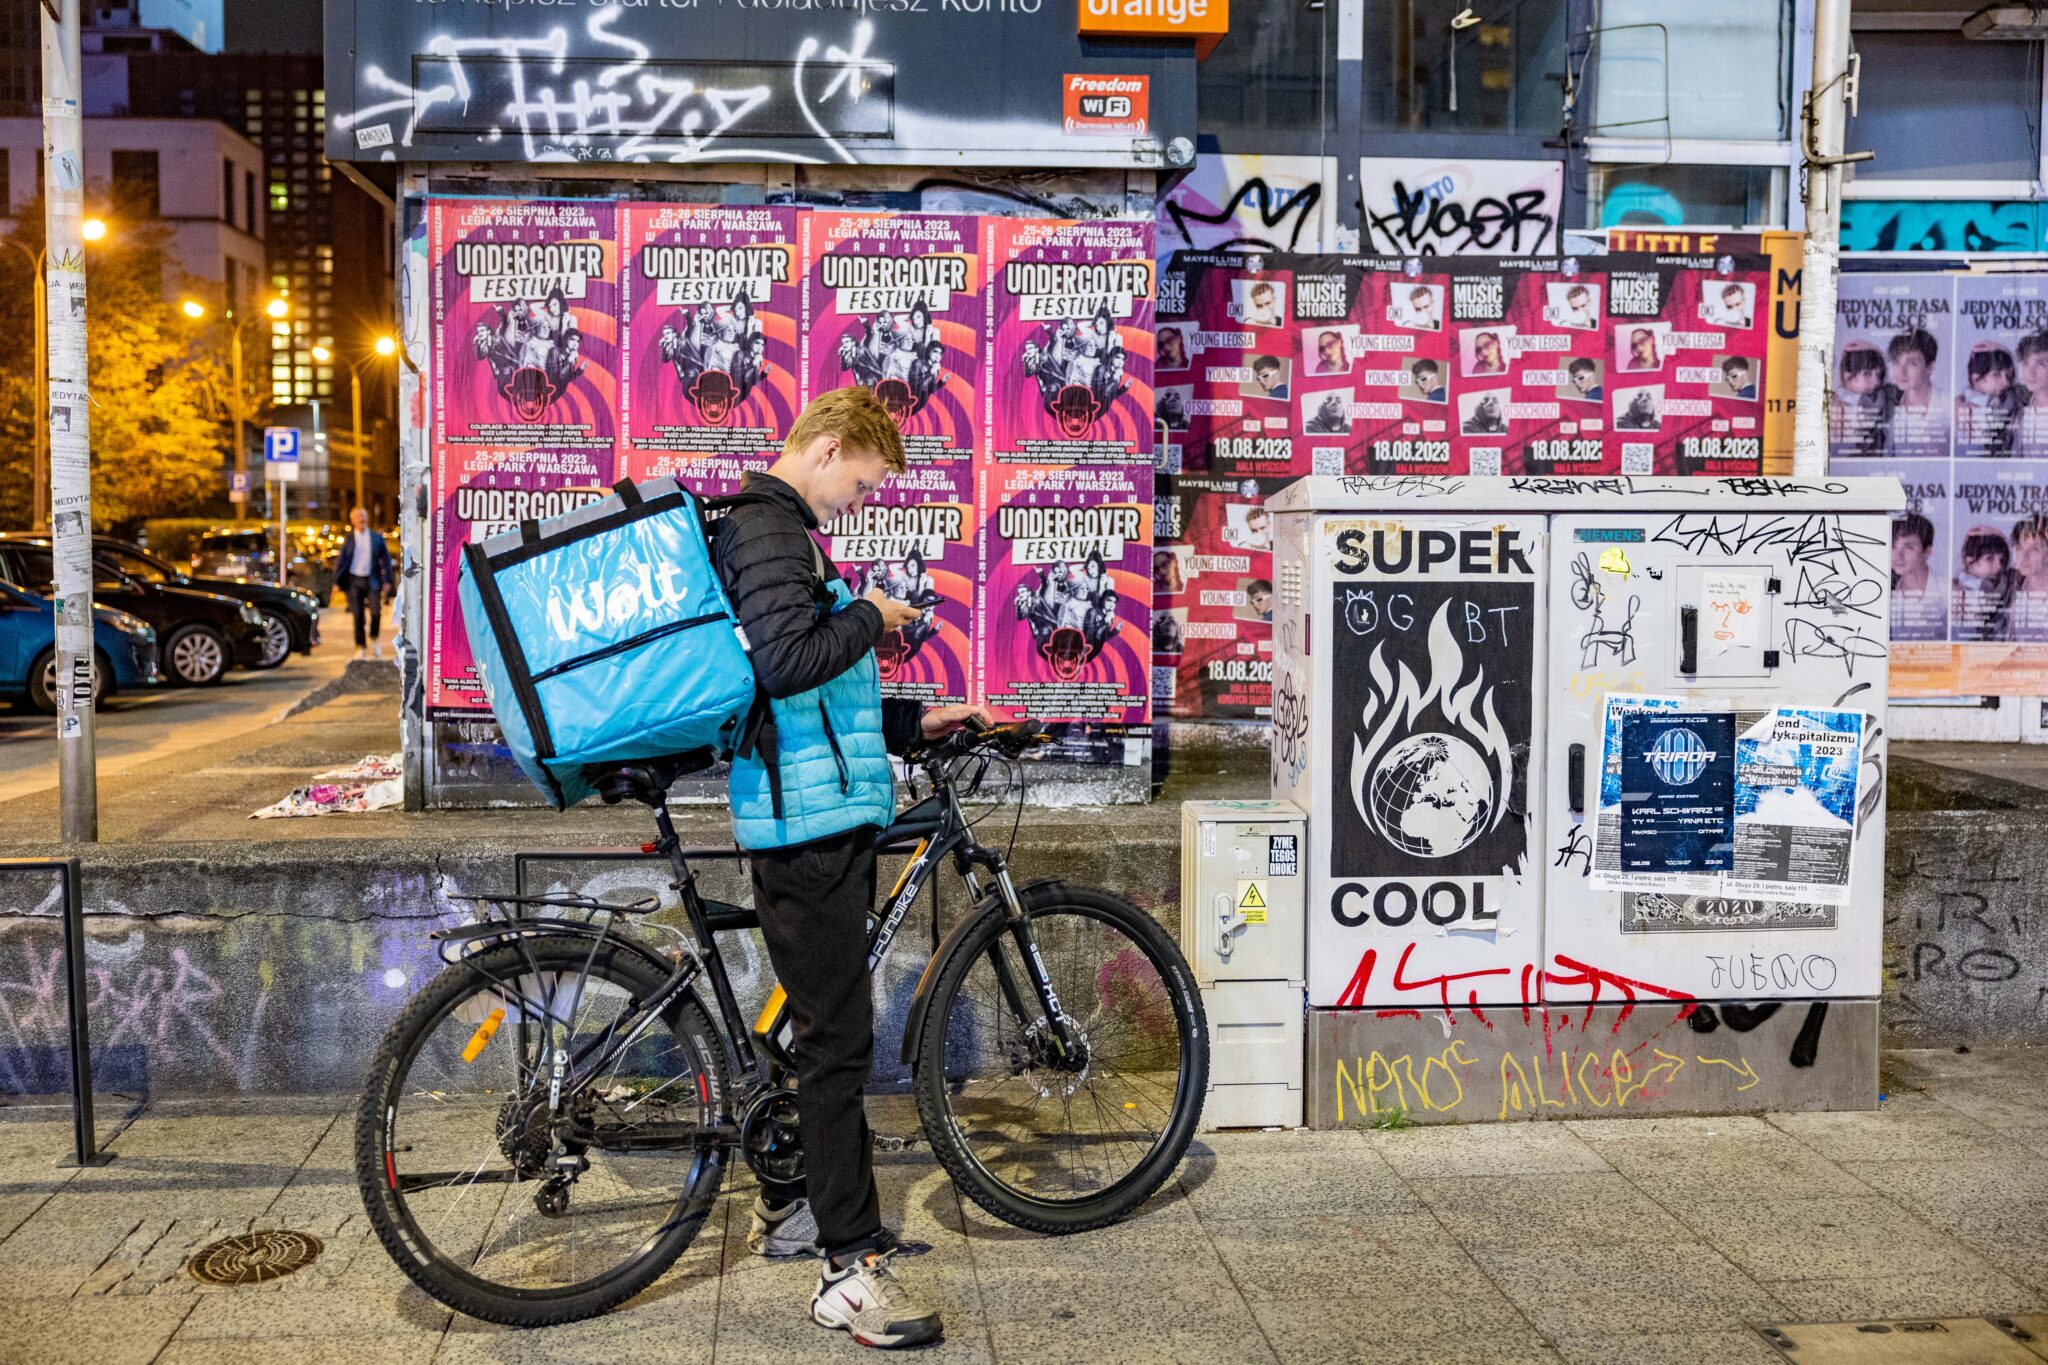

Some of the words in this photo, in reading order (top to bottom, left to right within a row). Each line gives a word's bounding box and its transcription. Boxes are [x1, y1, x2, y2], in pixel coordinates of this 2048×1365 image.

[1088, 0, 1207, 23] orange
[1070, 78, 1142, 92] Freedom
[472, 205, 502, 215] 25-26
[506, 206, 556, 216] SIERPNIA
[559, 207, 585, 217] 2023
[660, 209, 690, 218] 25-26
[694, 209, 743, 220] SIERPNIA
[746, 210, 771, 221] 2023
[461, 215, 492, 226] LEGIA
[495, 216, 524, 226] PARK
[534, 216, 596, 227] WARSZAWA
[649, 218, 680, 229] LEGIA
[683, 219, 710, 230] PARK
[722, 220, 782, 231] WARSZAWA
[840, 218, 870, 228] 25-26
[873, 219, 922, 230] SIERPNIA
[925, 220, 950, 230] 2023
[829, 228, 859, 238] LEGIA
[862, 228, 890, 240] PARK
[900, 230, 960, 241] WARSZAWA
[1024, 226, 1053, 236] 25-26
[1056, 227, 1105, 237] SIERPNIA
[1107, 228, 1132, 237] 2023
[1013, 236, 1042, 246] LEGIA
[1046, 236, 1073, 246] PARK
[1084, 237, 1143, 247] WARSZAWA
[456, 243, 601, 276] UNDERCOVER
[643, 247, 788, 281] UNDERCOVER
[1183, 255, 1242, 264] MAYBELLINE
[1344, 259, 1401, 267] MAYBELLINE
[1500, 260, 1558, 268] MAYBELLINE
[1657, 257, 1715, 265] MAYBELLINE
[823, 256, 965, 290] UNDERCOVER
[1006, 263, 1148, 295] UNDERCOVER
[484, 276, 574, 298] FESTIVAL
[671, 280, 759, 300] FESTIVAL
[1297, 284, 1346, 303] MUSIC
[1454, 285, 1503, 303] MUSIC
[1611, 281, 1659, 300] MUSIC
[849, 289, 938, 310] FESTIVAL
[1033, 296, 1121, 316] FESTIVAL
[1899, 299, 1949, 313] TRASA
[1229, 303, 1243, 316] OKI
[1297, 303, 1346, 317] STORIES
[1454, 304, 1503, 319] STORIES
[1611, 300, 1659, 314] STORIES
[1961, 300, 2021, 315] JEDYNA
[1974, 316, 1989, 329] W
[1190, 332, 1219, 346] YOUNG
[1223, 333, 1254, 347] LEOSIA
[1351, 336, 1379, 349] YOUNG
[1382, 336, 1412, 350] LEOSIA
[1208, 368, 1236, 381] YOUNG
[272, 432, 294, 459] P
[1214, 438, 1292, 459] 18.08.2023
[1374, 440, 1449, 462] 18.08.2023
[1683, 438, 1759, 458] 18.08.2023
[475, 452, 505, 462] 25-26
[509, 453, 557, 463] SIERPNIA
[561, 454, 587, 464] 2023
[658, 457, 688, 466] 25-26
[691, 458, 740, 469] SIERPNIA
[743, 460, 768, 470] 2023
[464, 461, 495, 472] LEGIA
[498, 462, 525, 472] PARK
[537, 463, 598, 475] WARSZAWA
[646, 466, 676, 477] LEGIA
[680, 467, 707, 478] PARK
[921, 470, 946, 480] 2023
[1016, 470, 1045, 480] 25-26
[1048, 470, 1096, 481] SIERPNIA
[1099, 471, 1124, 481] 2023
[896, 480, 956, 491] WARSZAWA
[1005, 480, 1035, 490] LEGIA
[1038, 481, 1065, 490] PARK
[1075, 481, 1135, 492] WARSZAWA
[1179, 480, 1238, 488] MAYBELLINE
[1955, 484, 2016, 499] JEDYNA
[1968, 501, 1983, 513] W
[1000, 508, 1139, 540] UNDERCOVER
[1223, 528, 1238, 541] OKI
[1579, 529, 1642, 542] SIEMENS
[844, 539, 932, 558] FESTIVAL
[1026, 540, 1112, 559] FESTIVAL
[1335, 529, 1534, 574] SUPER
[1216, 557, 1247, 570] LEOSIA
[547, 562, 688, 641] Wolt
[1643, 752, 1717, 762] TRIADA
[1273, 837, 1293, 849] ZYME
[1271, 849, 1295, 862] TEGOS
[1270, 863, 1296, 875] DHOKE
[1331, 882, 1498, 927] COOL
[1706, 900, 1754, 915] 2020
